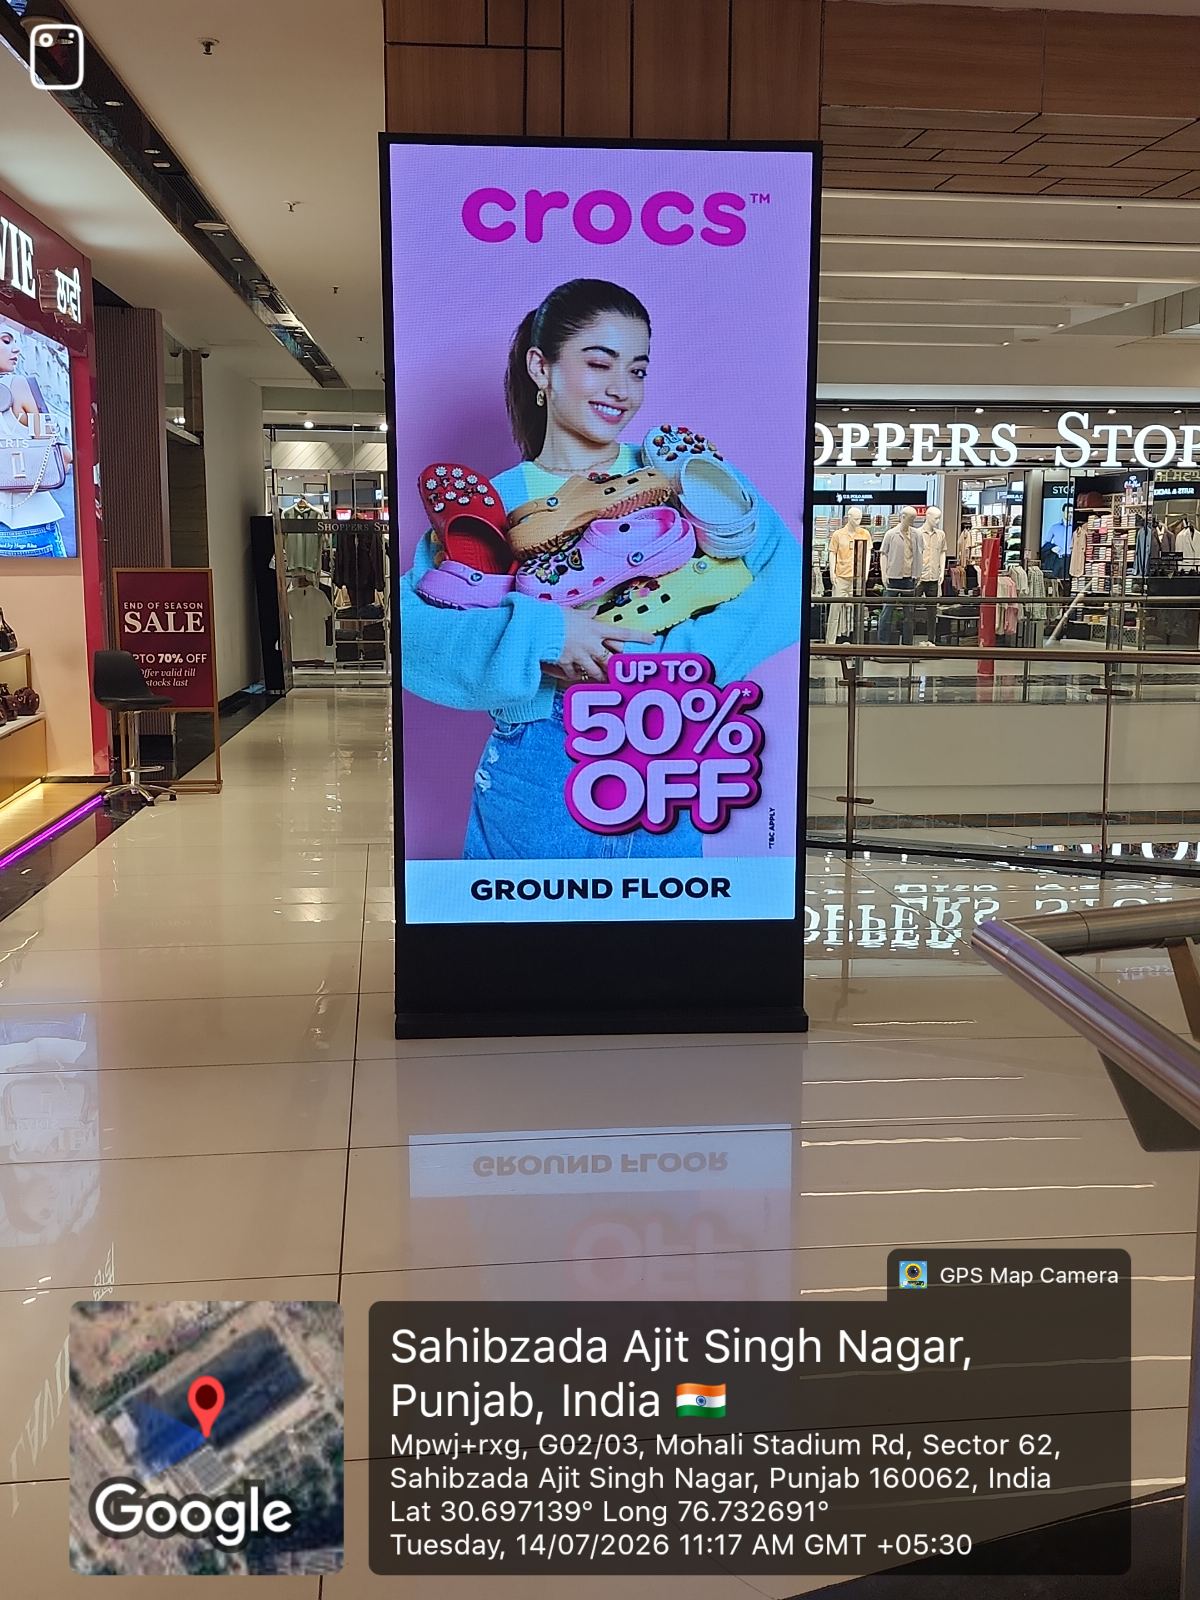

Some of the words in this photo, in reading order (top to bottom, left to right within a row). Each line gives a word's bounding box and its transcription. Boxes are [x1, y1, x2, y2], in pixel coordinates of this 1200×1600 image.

[461, 187, 747, 247] crocs
[374, 521, 389, 532] ST
[123, 602, 143, 610] END
[147, 602, 160, 610] OF
[164, 602, 204, 610] SEASON
[124, 611, 205, 634] SALE
[132, 654, 156, 664] PTO
[157, 653, 184, 664] 70%
[186, 653, 208, 664] OFF
[160, 667, 182, 677] valid
[184, 668, 196, 677] till
[172, 678, 189, 687] last
[615, 660, 657, 683] UP
[661, 659, 703, 683] TO
[572, 758, 751, 825] OFF
[768, 807, 776, 831] APPLY
[470, 878, 613, 901] GROUND
[622, 876, 732, 900] FLOOR
